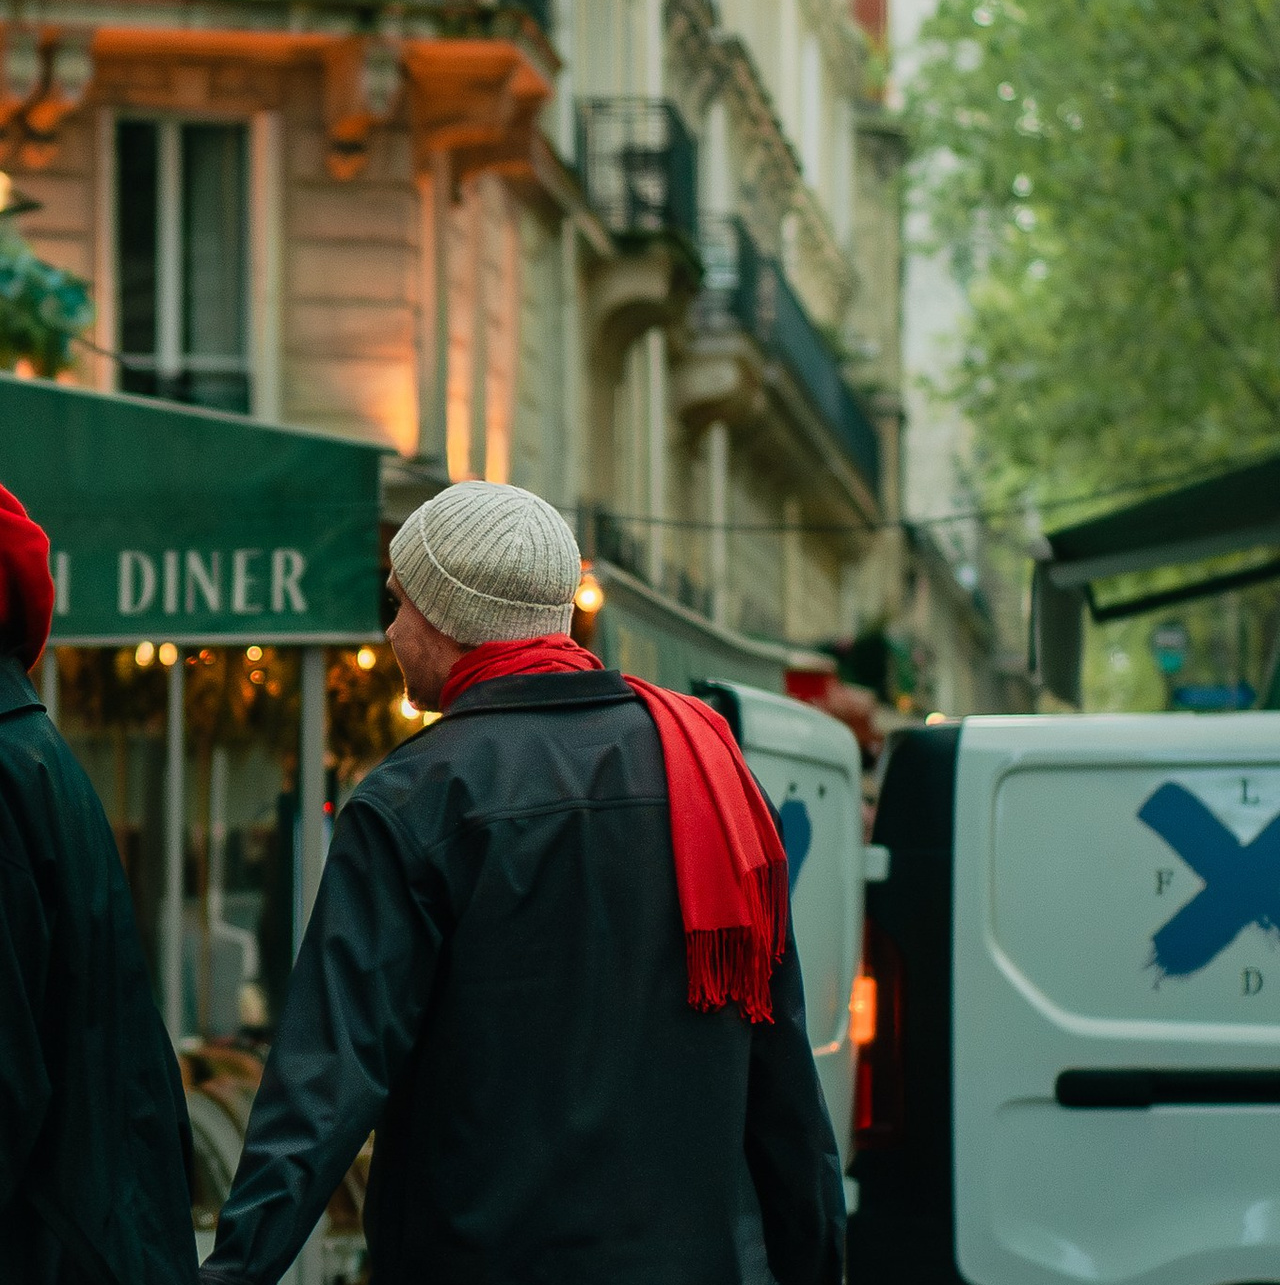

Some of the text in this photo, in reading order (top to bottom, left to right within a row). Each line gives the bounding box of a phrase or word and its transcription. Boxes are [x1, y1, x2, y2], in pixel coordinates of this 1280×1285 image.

[118, 547, 309, 616] DINER
[1156, 868, 1174, 896] F
[1241, 966, 1264, 996] D
